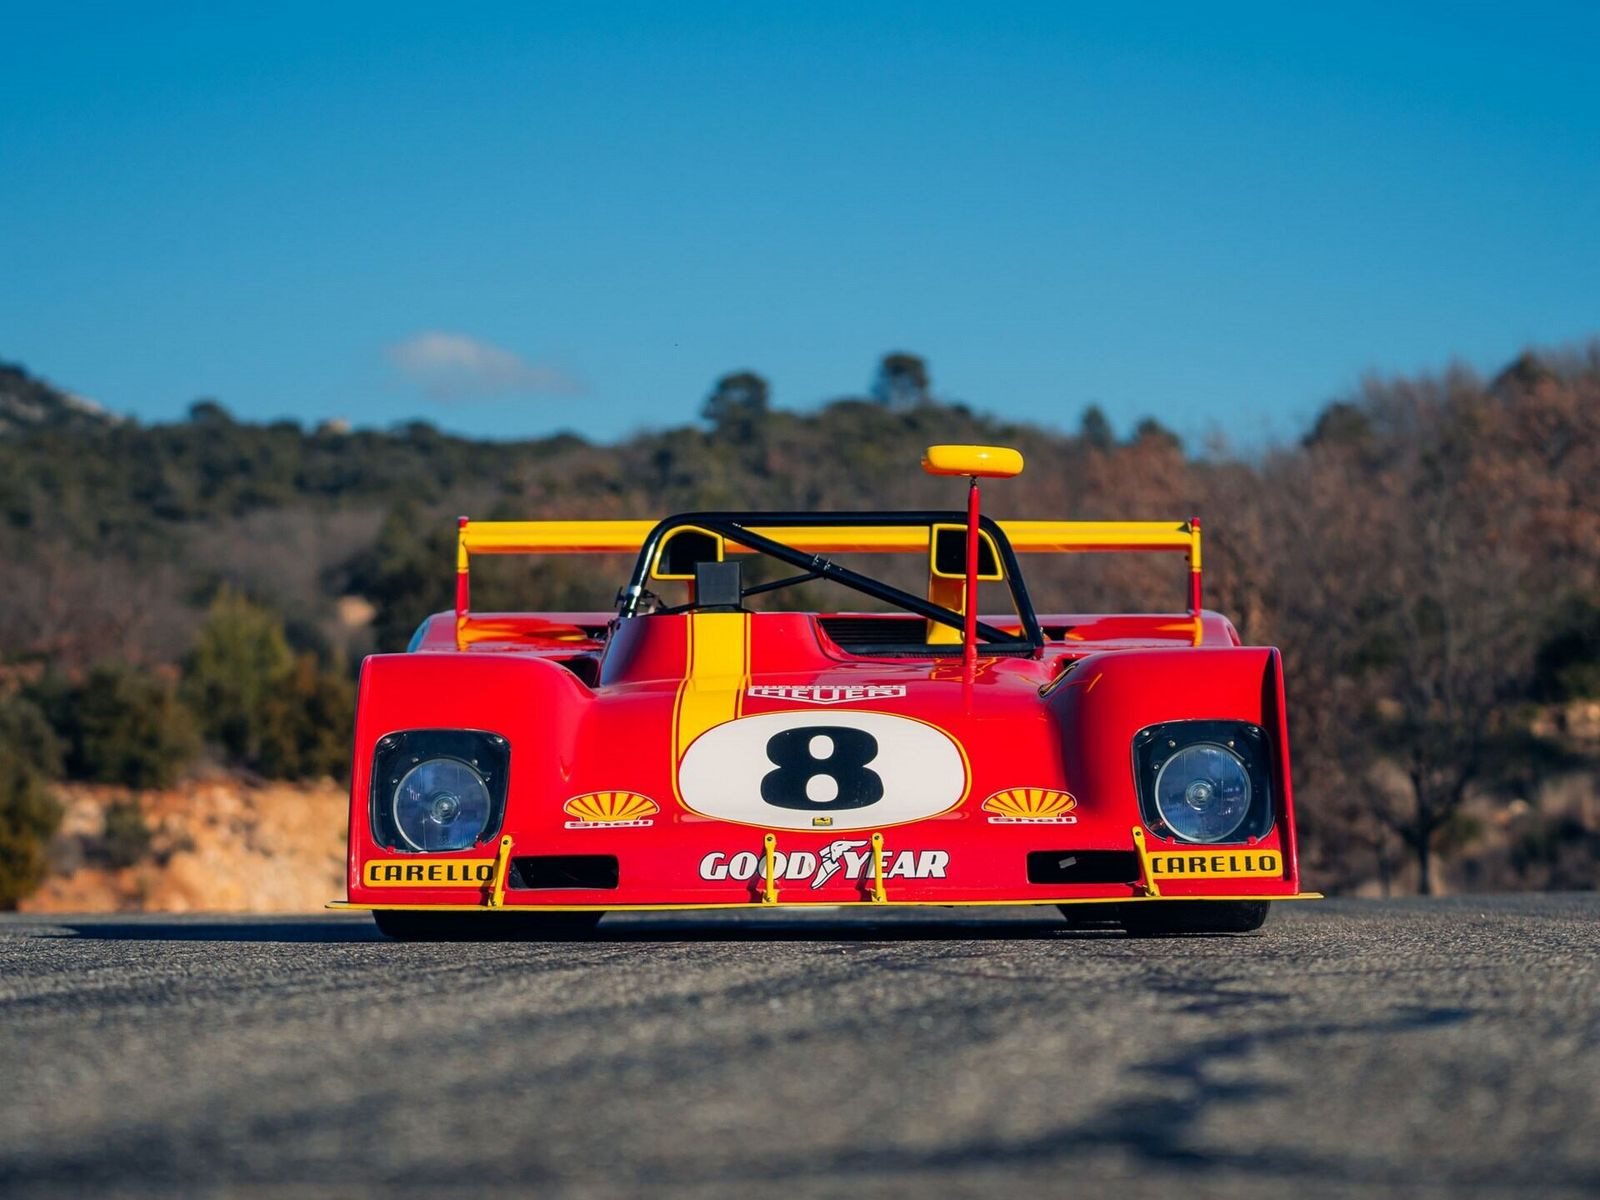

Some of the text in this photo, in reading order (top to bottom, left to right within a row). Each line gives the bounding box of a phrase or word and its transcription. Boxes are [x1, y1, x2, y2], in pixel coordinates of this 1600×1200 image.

[761, 686, 894, 701] HEUER
[760, 725, 884, 811] 8
[370, 864, 494, 881] CARELLO
[1151, 855, 1276, 873] CARELLO
